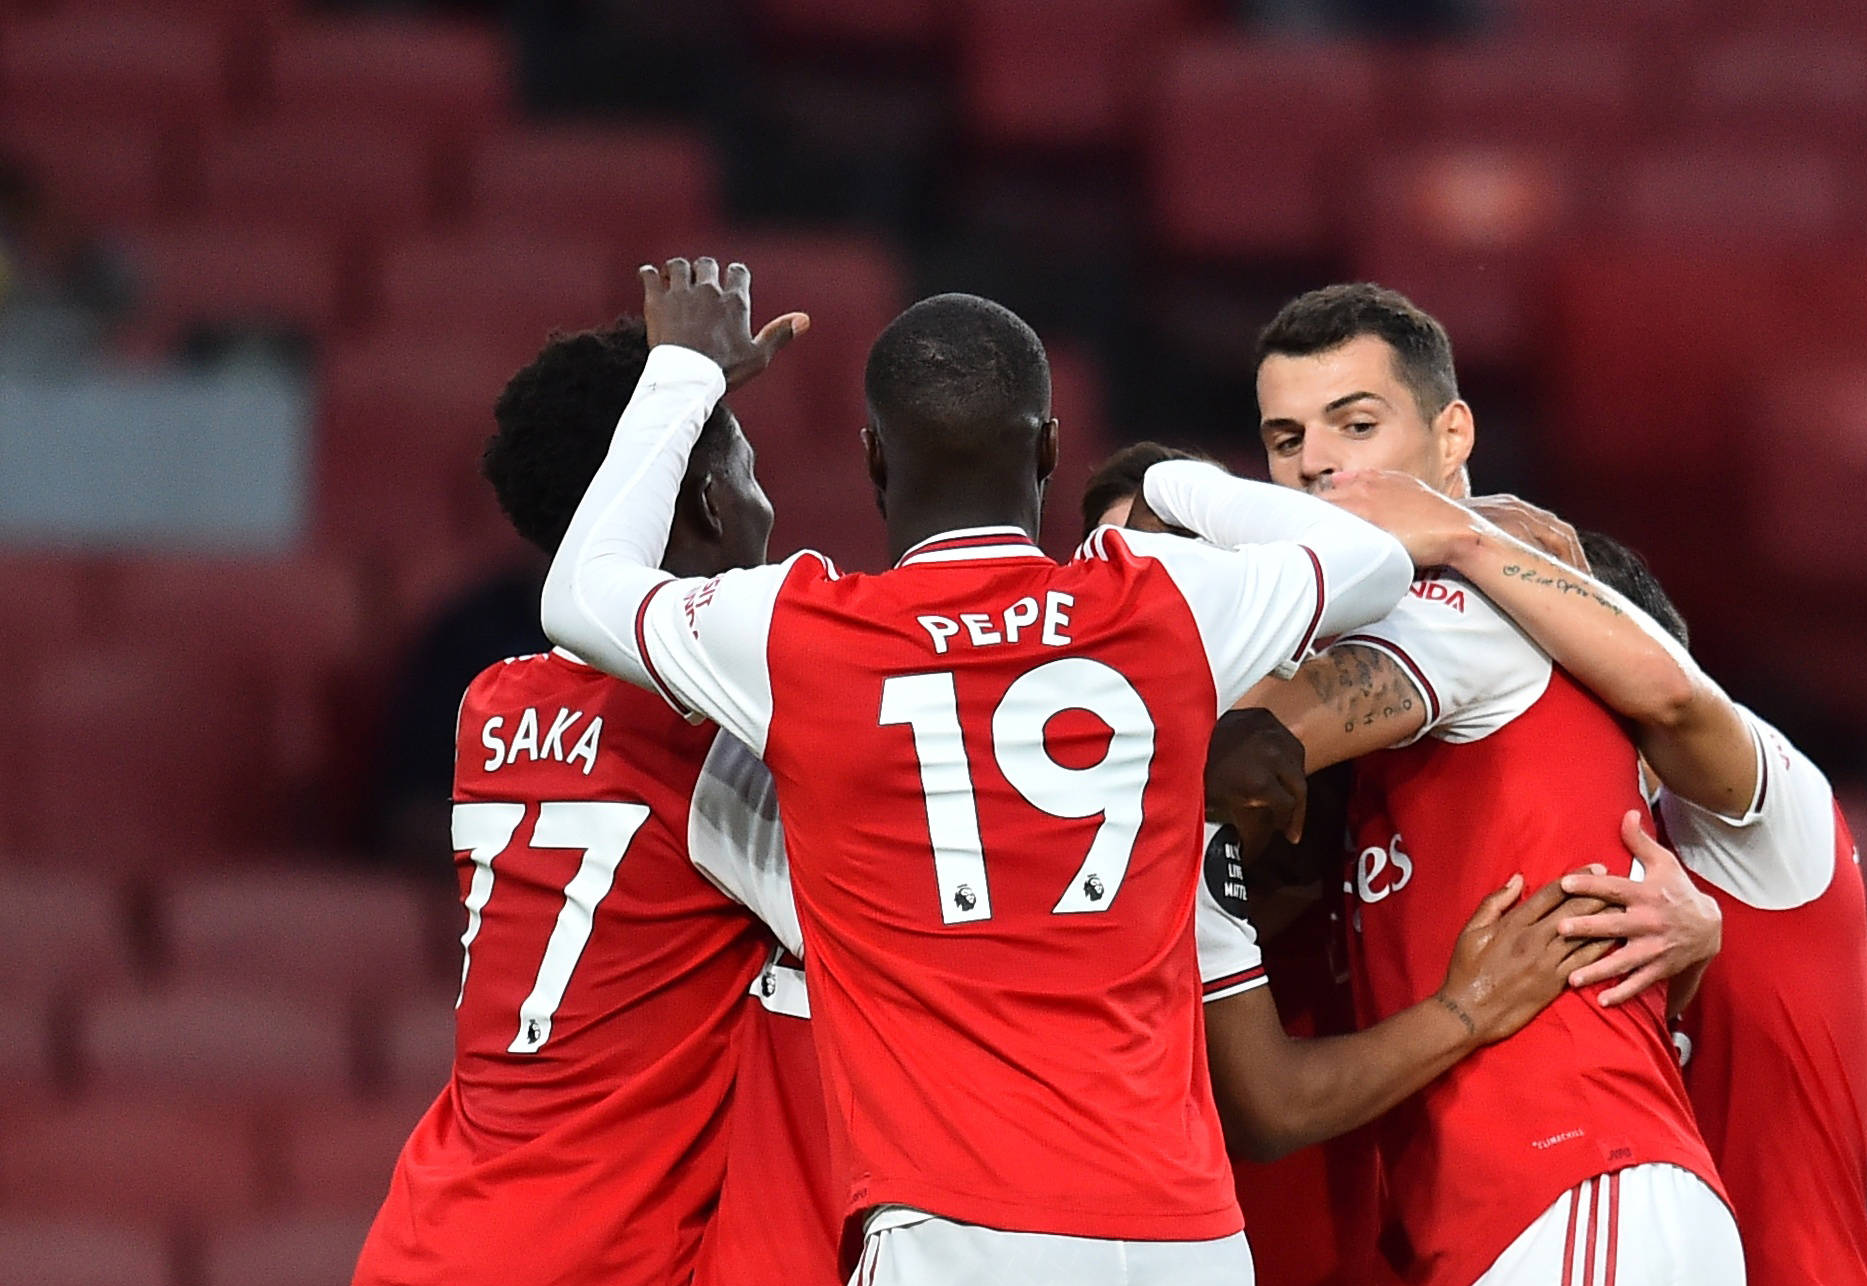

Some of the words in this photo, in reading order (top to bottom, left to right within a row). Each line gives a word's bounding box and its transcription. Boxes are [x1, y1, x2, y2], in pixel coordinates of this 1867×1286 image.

[916, 590, 1075, 655] PEPE
[481, 707, 603, 776] SAKA
[878, 657, 1156, 926] 19
[451, 801, 651, 1055] 77
